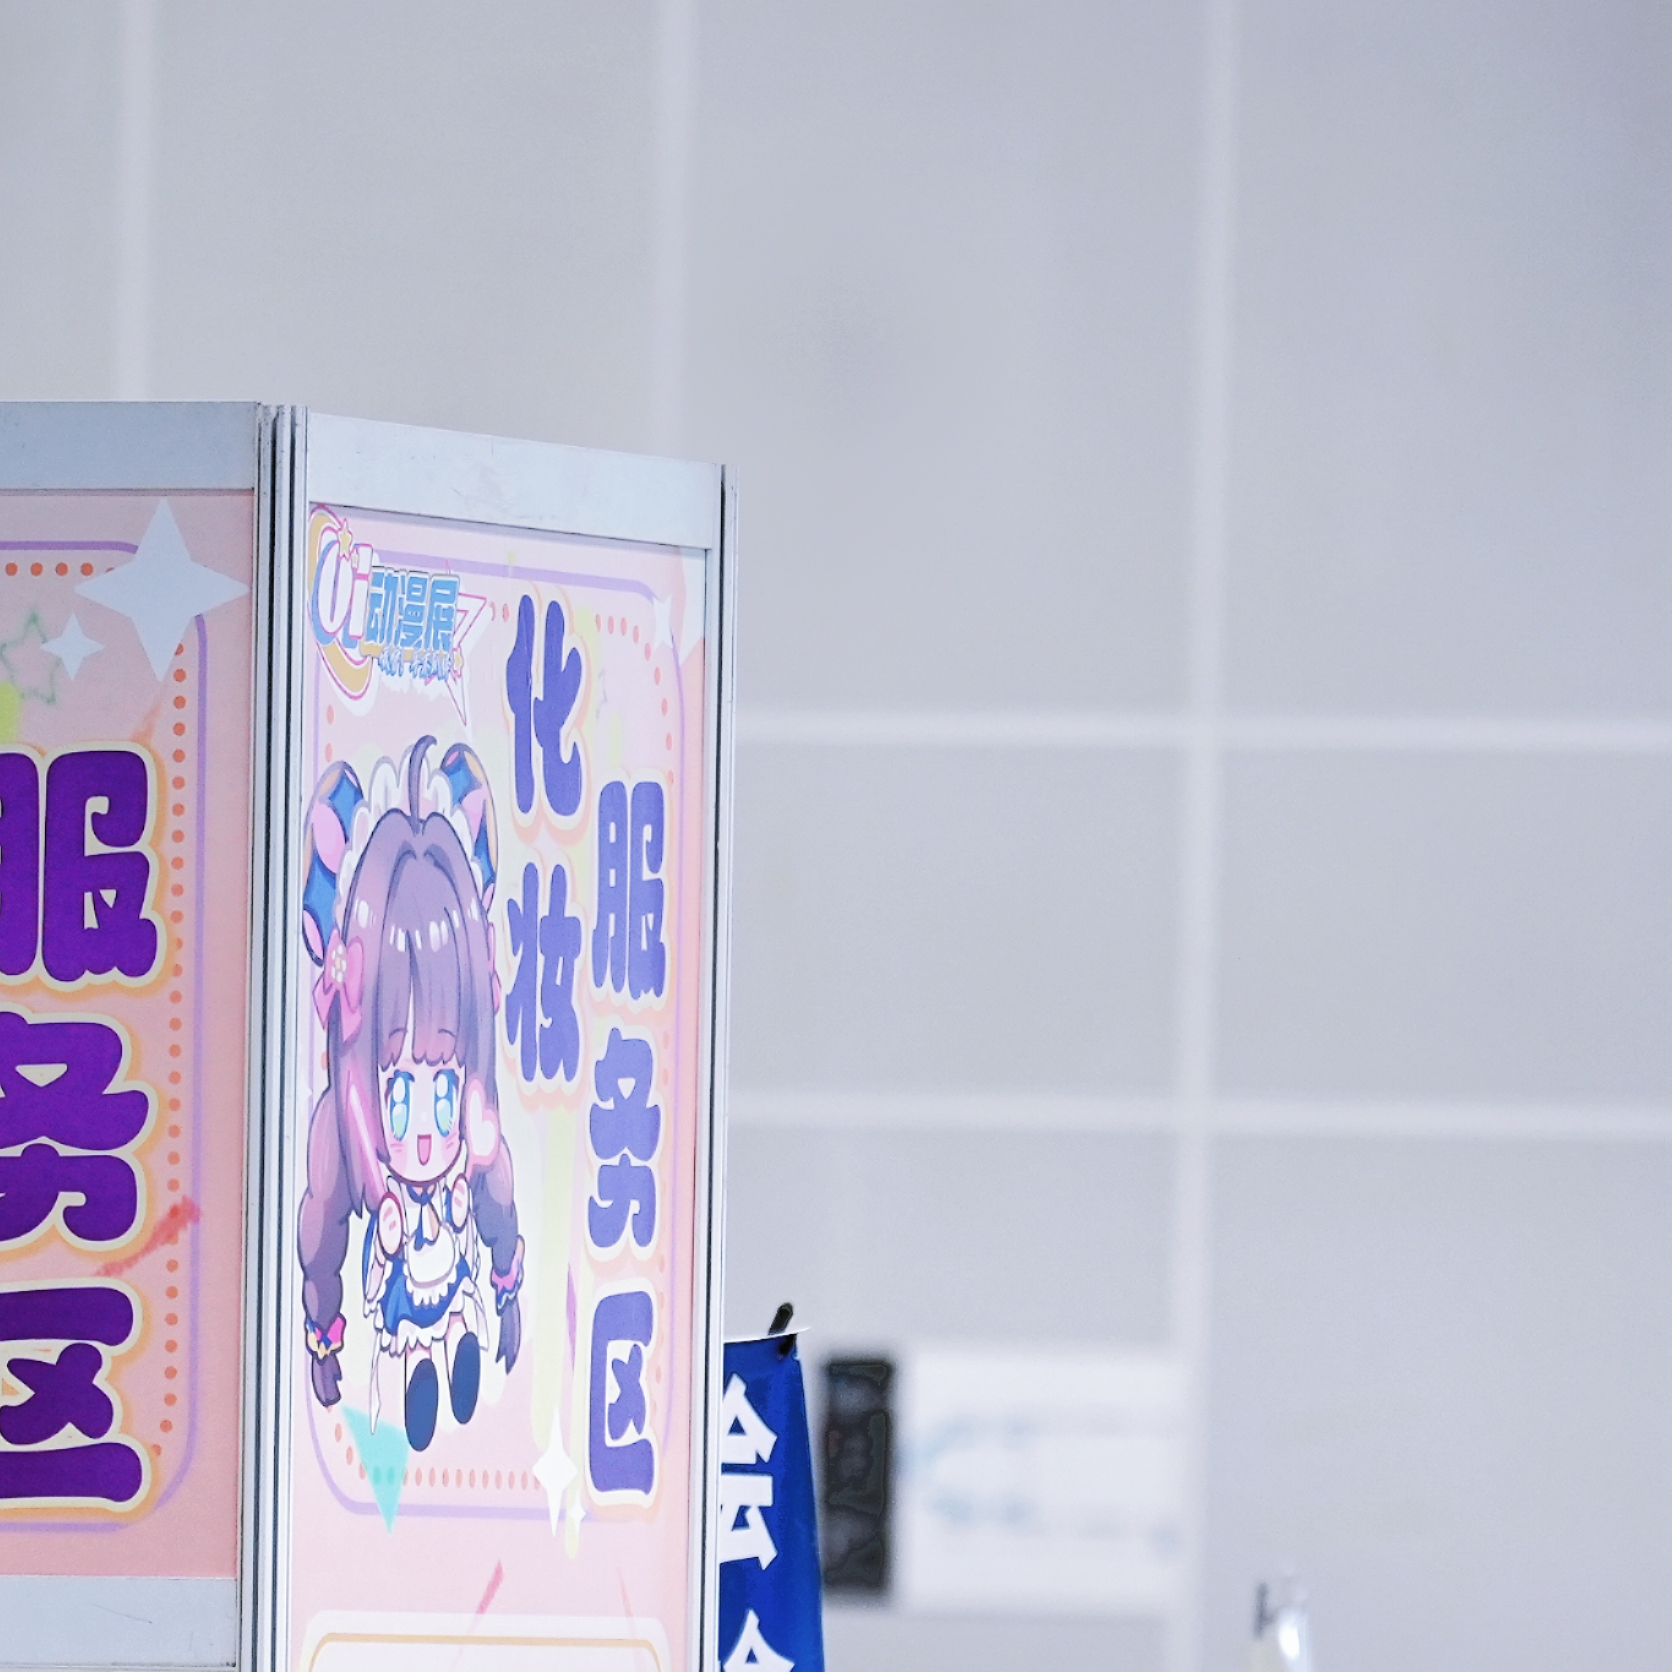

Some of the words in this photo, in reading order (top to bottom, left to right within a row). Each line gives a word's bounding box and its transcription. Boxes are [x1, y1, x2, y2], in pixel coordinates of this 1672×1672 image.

[507, 594, 579, 1081] 化妆
[589, 779, 664, 1492] 服务区
